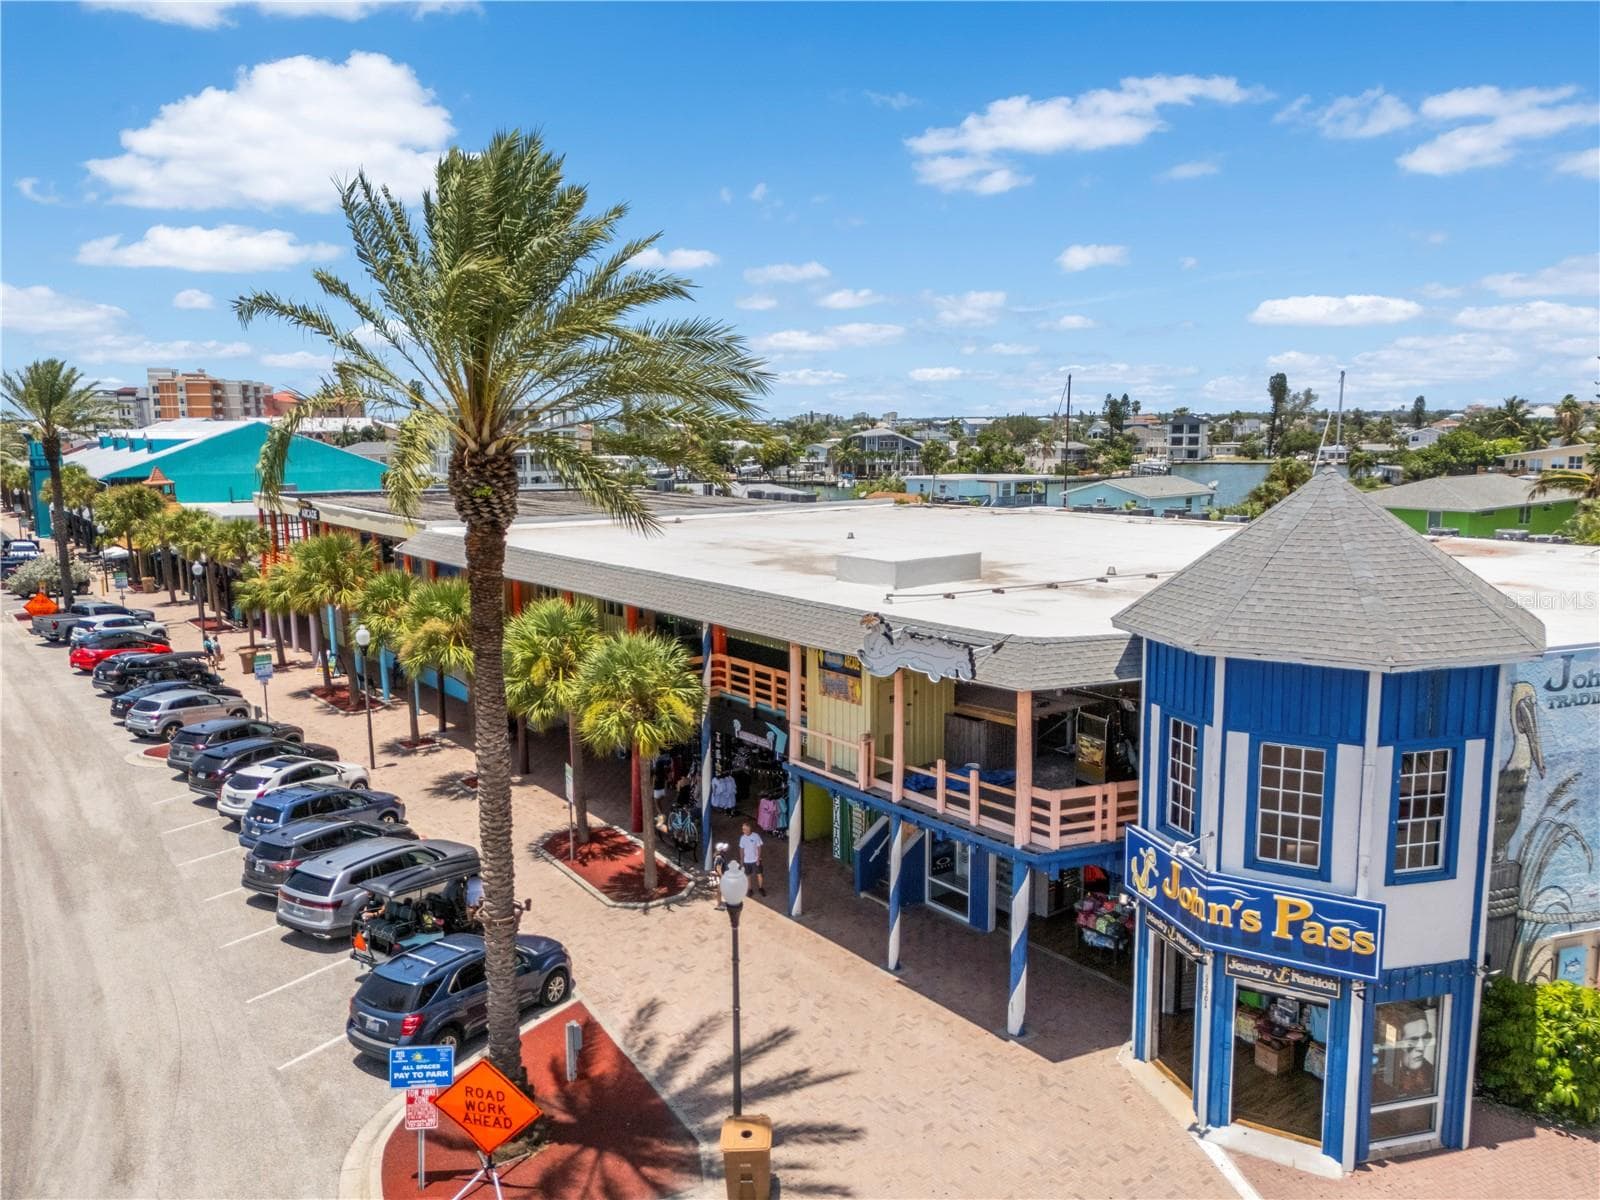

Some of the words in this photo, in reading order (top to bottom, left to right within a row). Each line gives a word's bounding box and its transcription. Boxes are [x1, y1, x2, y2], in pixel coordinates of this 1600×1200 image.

[1162, 860, 1262, 933] John's
[1271, 894, 1376, 955] Pass
[1228, 958, 1273, 978] Jewelry
[1291, 970, 1337, 990] Fashion
[425, 1070, 449, 1078] PARK
[465, 1085, 505, 1102] ROAD
[465, 1100, 506, 1115] WORK
[463, 1112, 513, 1129] AHEAD
